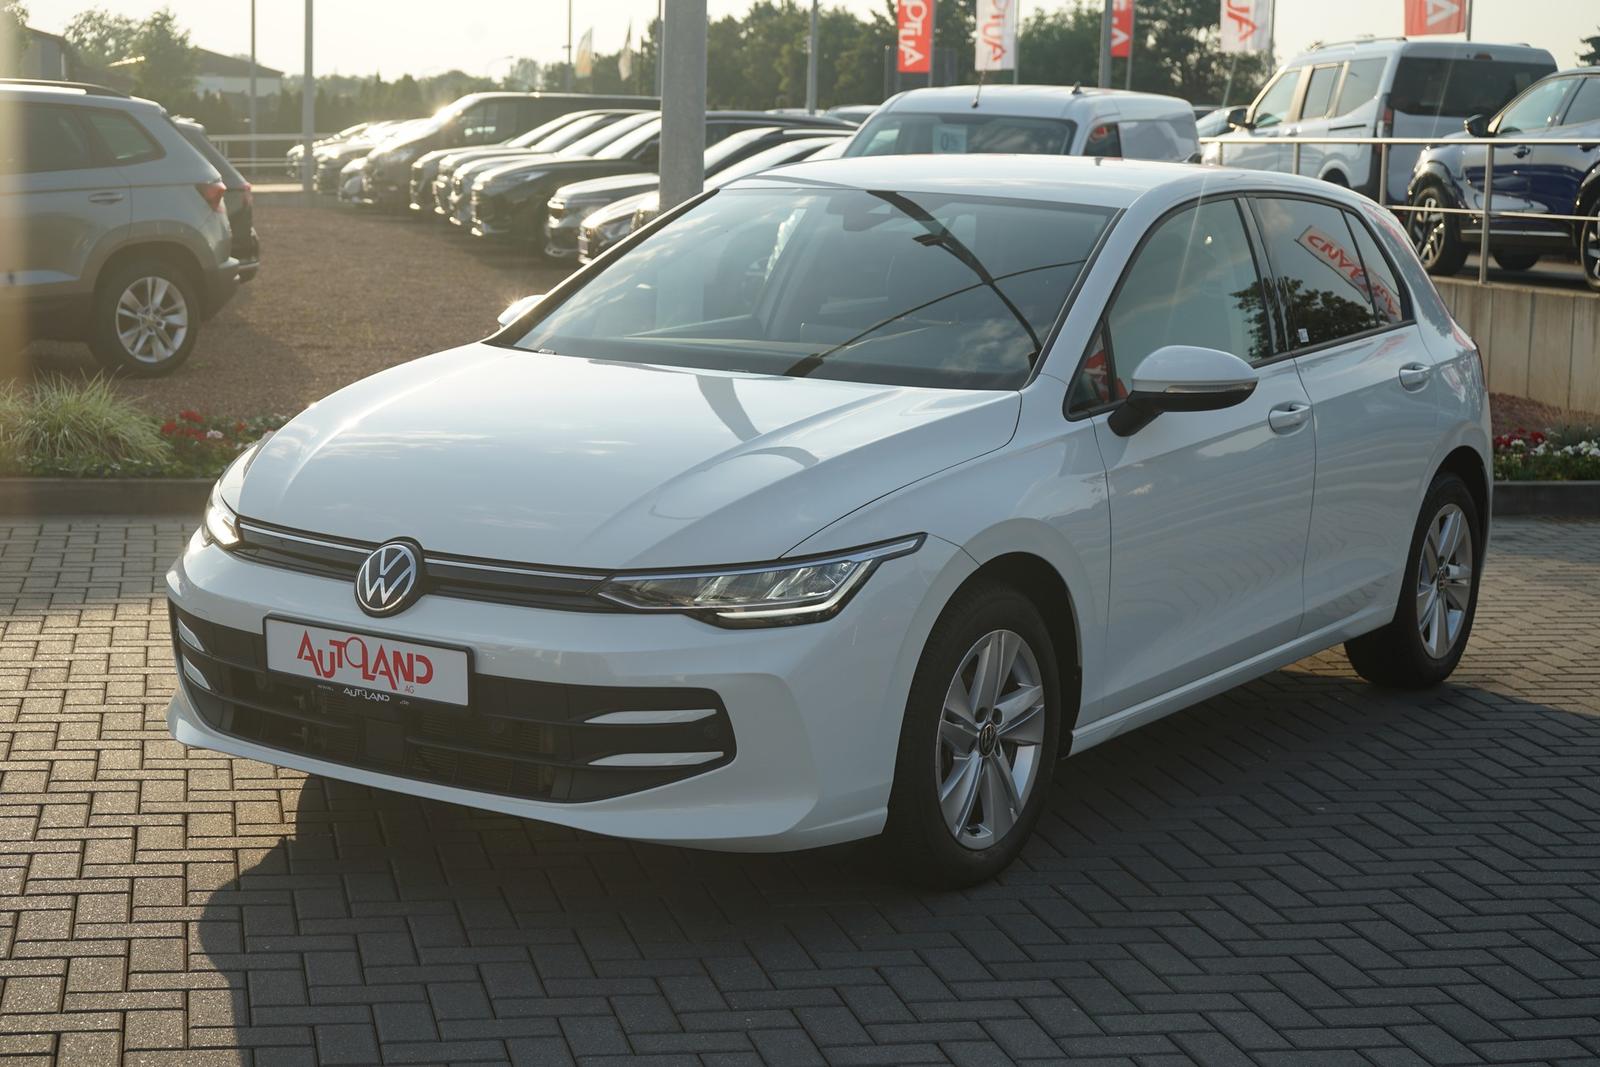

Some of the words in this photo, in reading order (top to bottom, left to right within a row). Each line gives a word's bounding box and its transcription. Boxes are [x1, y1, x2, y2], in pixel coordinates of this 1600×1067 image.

[297, 629, 434, 691] AUTOLAND
[343, 687, 391, 703] AUTOLAND
[404, 685, 416, 695] AG
